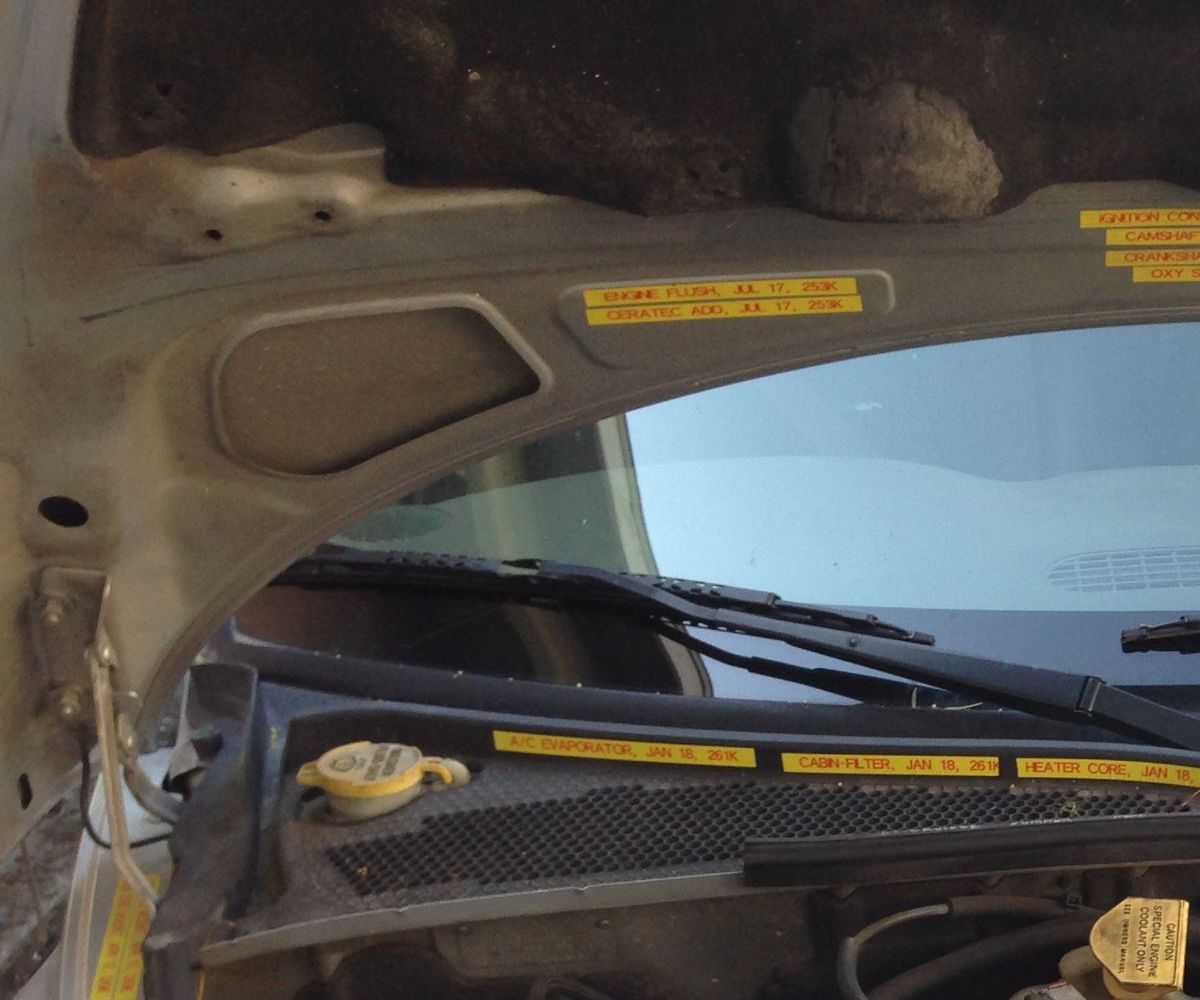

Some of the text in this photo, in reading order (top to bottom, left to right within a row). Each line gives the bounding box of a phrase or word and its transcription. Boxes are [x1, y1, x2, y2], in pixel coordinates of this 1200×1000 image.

[1151, 268, 1182, 279] OXY
[667, 285, 720, 298] FLUSH,
[733, 284, 759, 294] JUL
[769, 283, 790, 294] 17,
[607, 307, 682, 320] CERATEC
[691, 305, 728, 316] ADD,
[740, 303, 766, 313] JUL
[776, 302, 796, 312] 17,
[510, 737, 535, 749] A/C
[540, 739, 637, 758] EVAPORATOR,
[646, 746, 672, 758] JAN
[906, 759, 932, 770] JAN
[940, 760, 959, 772] 18,
[1025, 762, 1080, 773] HEATER
[1088, 763, 1130, 777] CORE,
[1141, 766, 1167, 779] JAN
[1176, 769, 1193, 783] 18,
[1136, 907, 1149, 972] COOLANT ONLY
[1149, 905, 1163, 977] SPECIAL ENGINE
[1165, 923, 1176, 961] CAUTION
